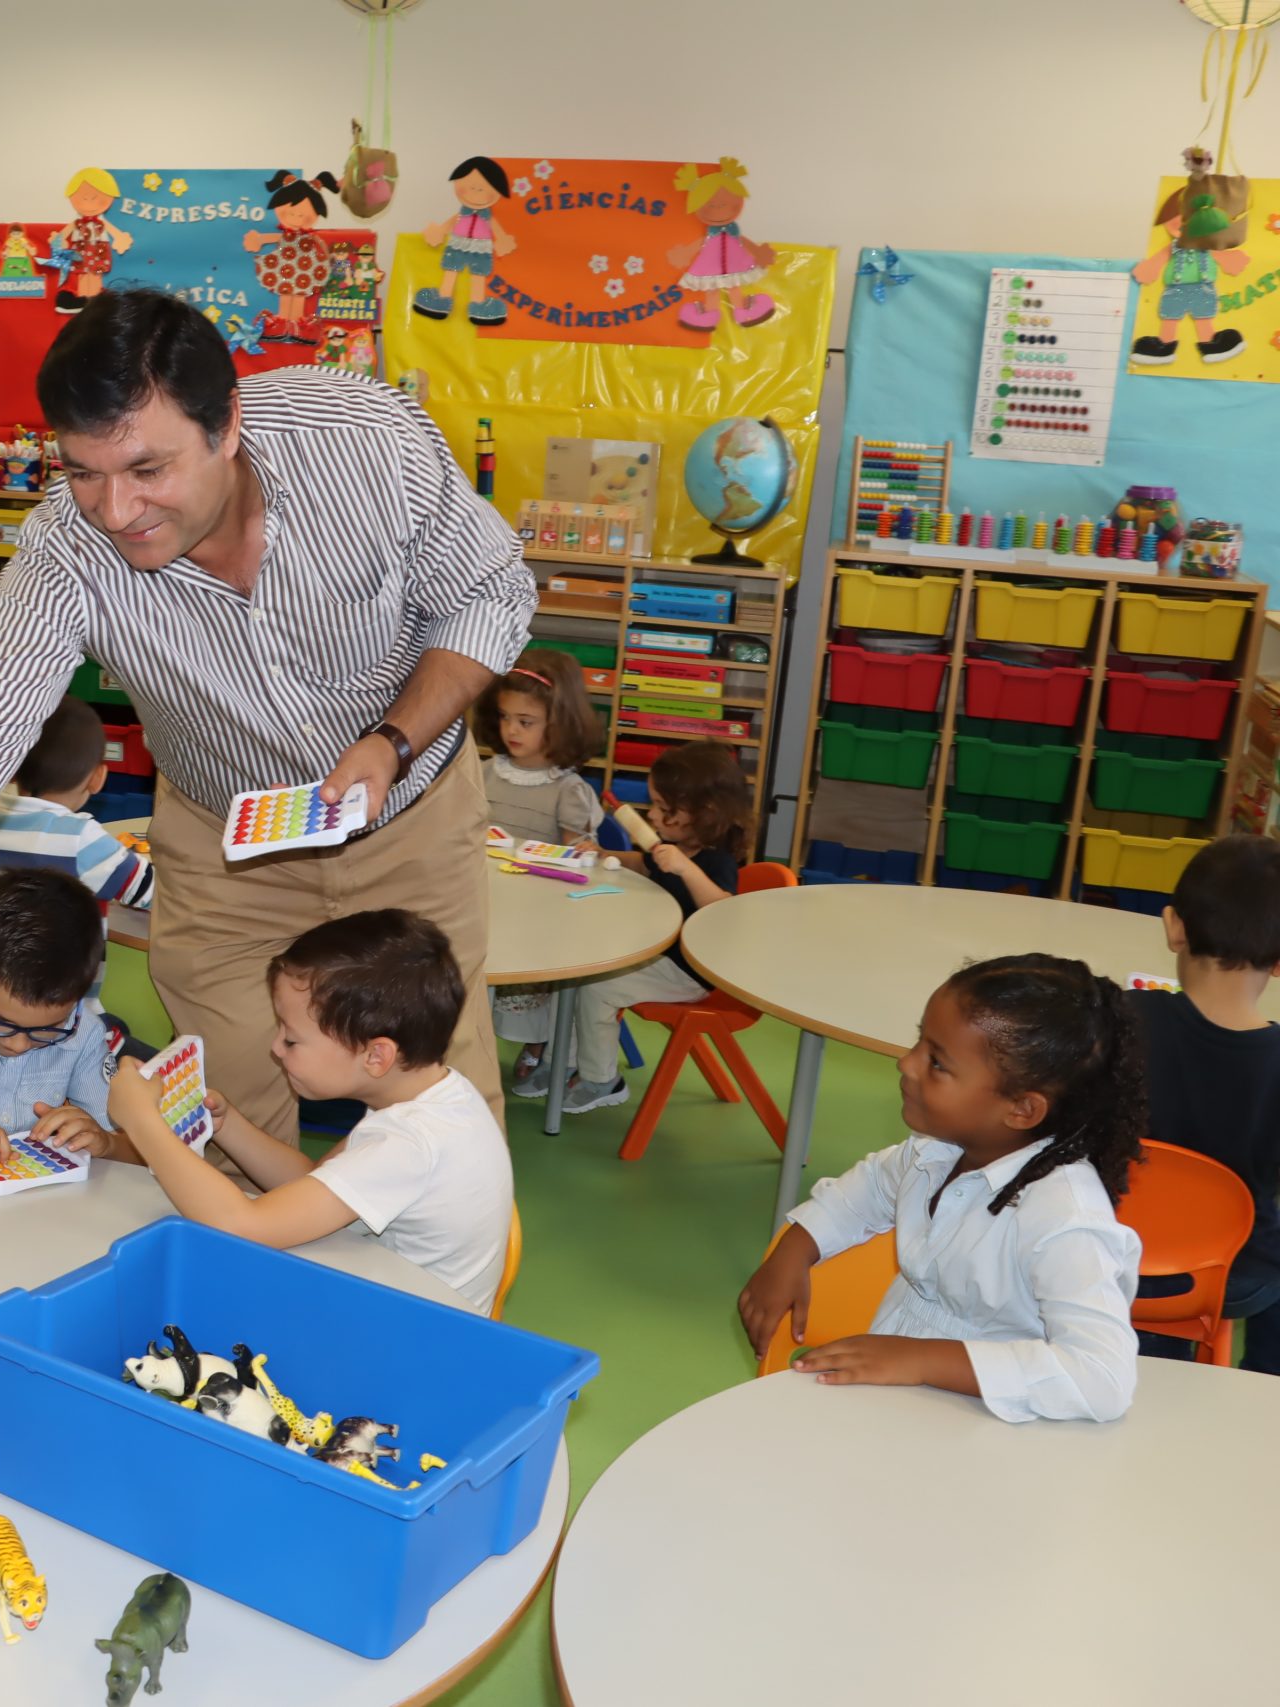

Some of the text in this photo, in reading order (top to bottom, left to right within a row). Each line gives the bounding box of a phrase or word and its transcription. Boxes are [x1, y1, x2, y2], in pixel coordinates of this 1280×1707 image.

[120, 196, 266, 223] EXPRESSÃO
[1219, 268, 1280, 313] MAT
[992, 296, 1004, 308] 2
[320, 308, 375, 320] COLAGEM
